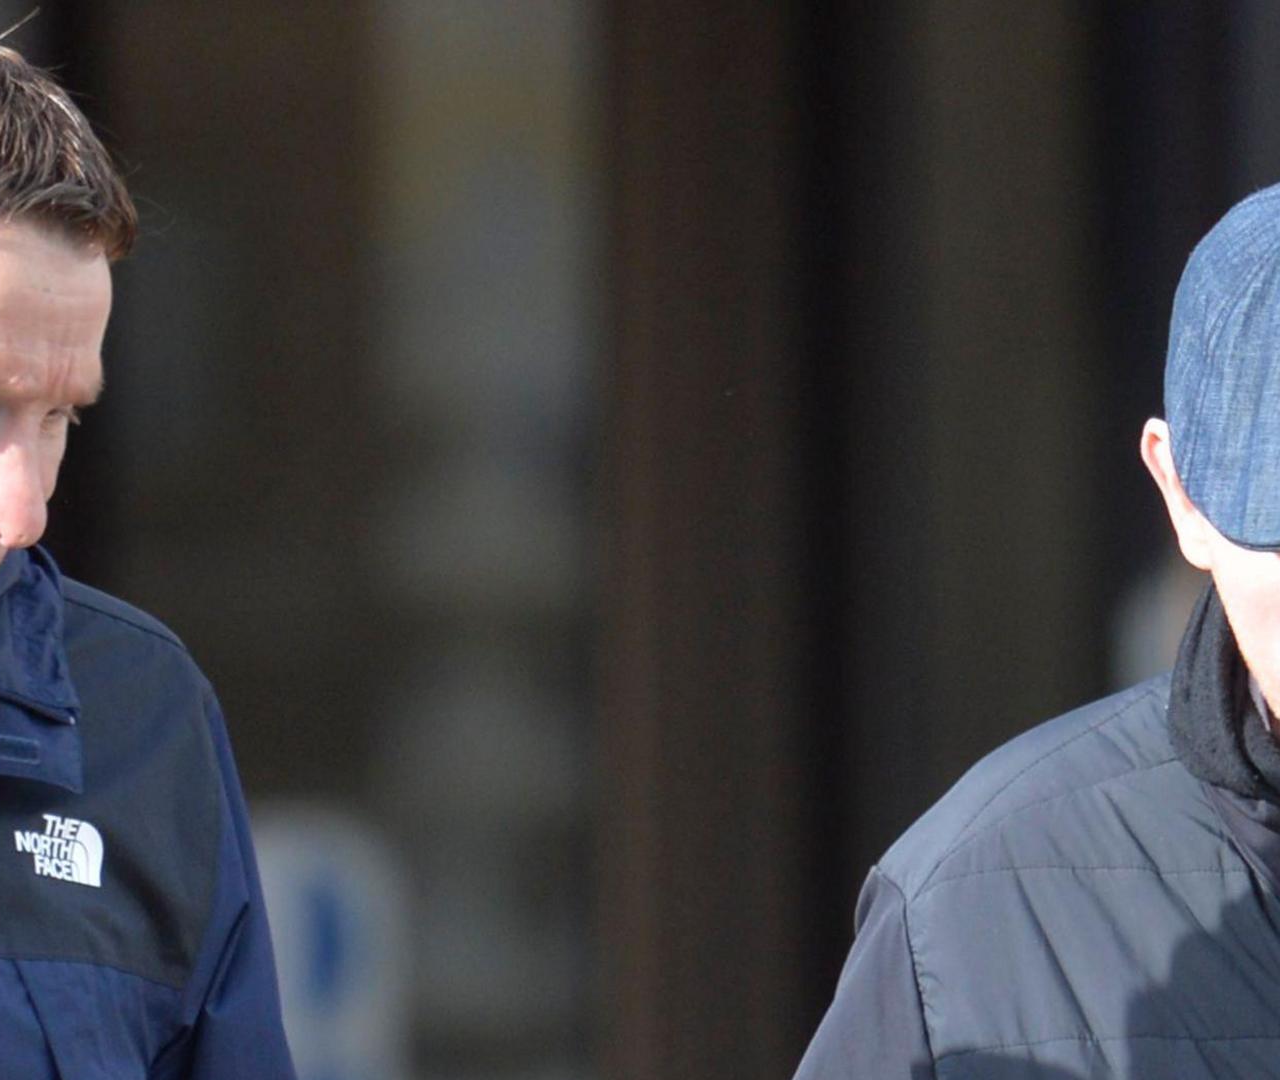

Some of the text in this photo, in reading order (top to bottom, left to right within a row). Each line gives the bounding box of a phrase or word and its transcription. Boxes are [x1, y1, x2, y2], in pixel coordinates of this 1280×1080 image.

[42, 813, 80, 840] THE
[14, 830, 73, 860] NORTH
[34, 854, 73, 881] FACE
